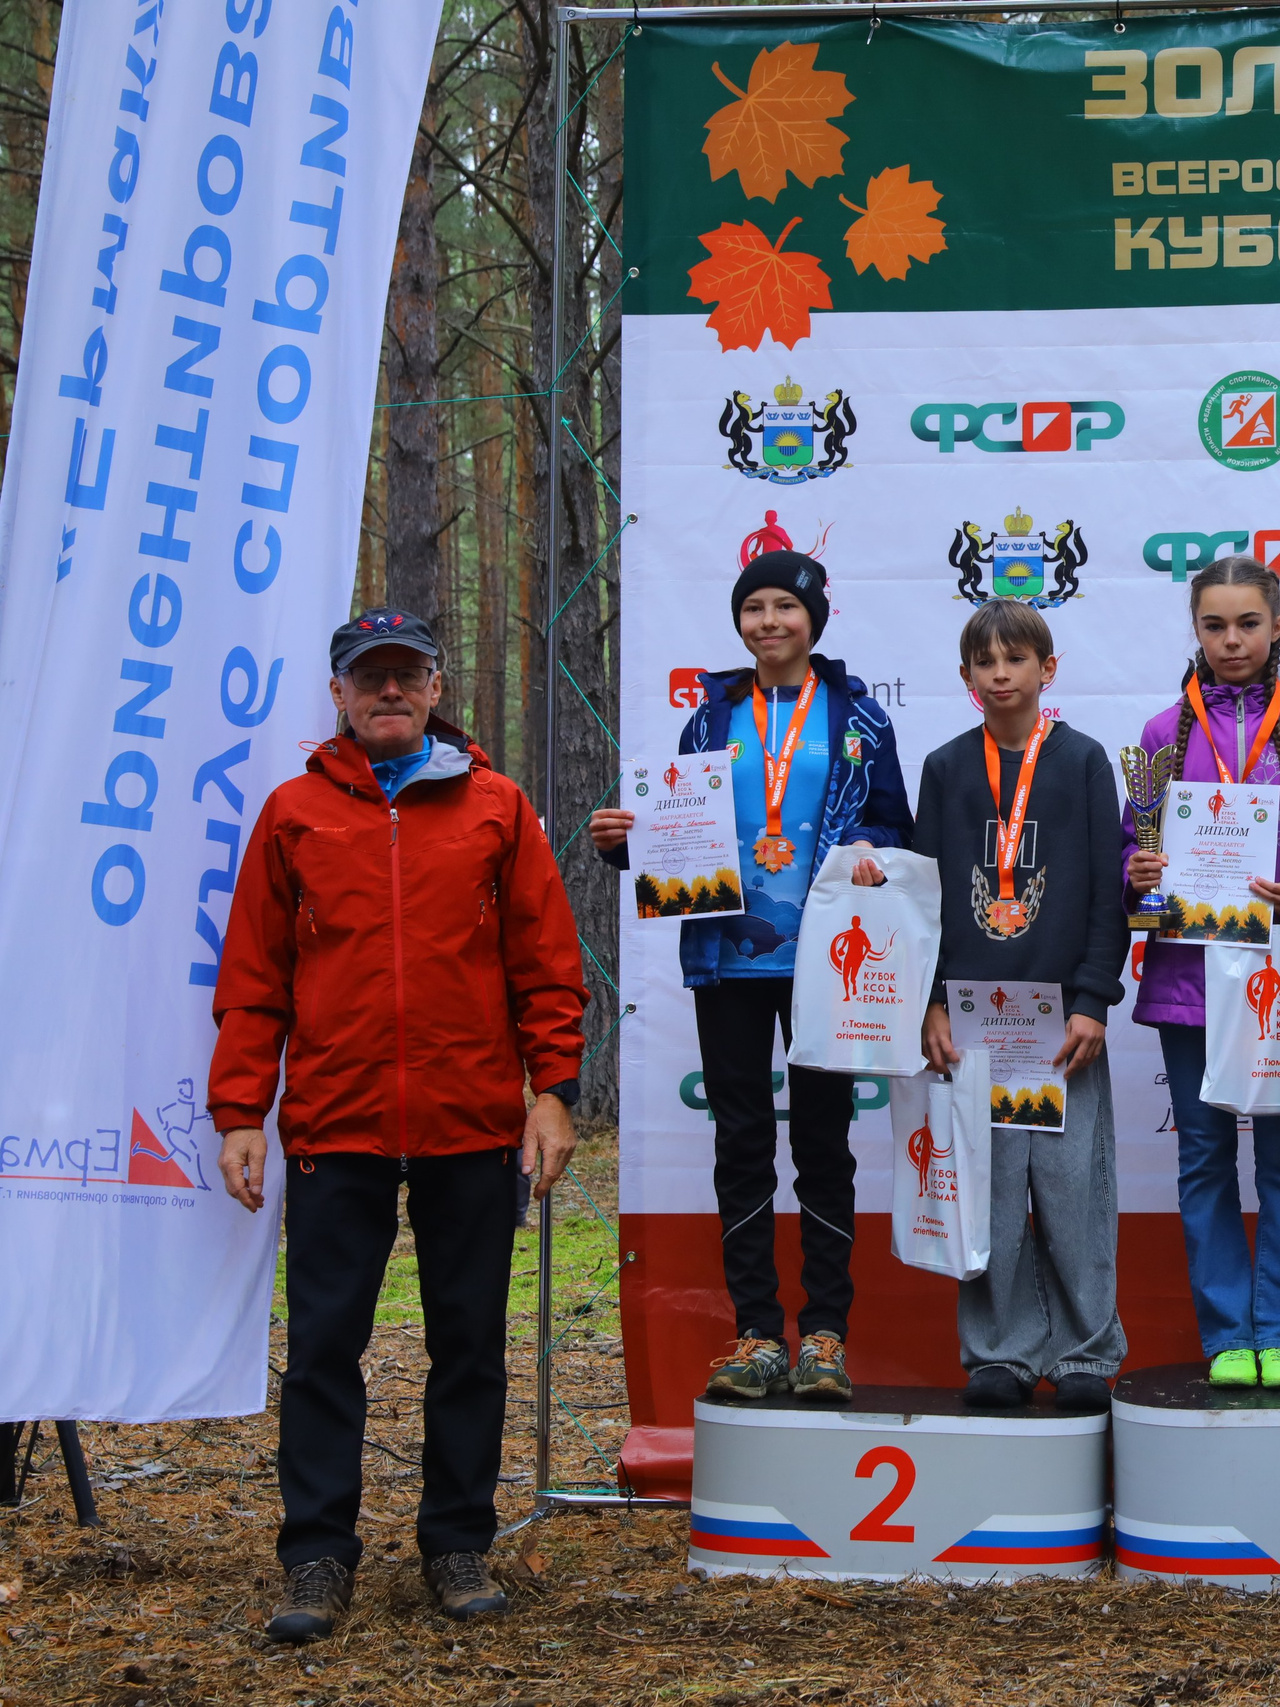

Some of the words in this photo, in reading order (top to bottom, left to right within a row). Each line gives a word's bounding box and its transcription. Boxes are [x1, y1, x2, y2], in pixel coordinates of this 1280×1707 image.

[1203, 385, 1226, 423] ФЕДЕРАЦИЯ
[1229, 375, 1278, 390] СПОРТИВНОГО
[771, 780, 784, 807] КУБОК
[654, 796, 707, 812] ДИПЛОМ
[1003, 842, 1015, 869] КУБОК
[1010, 823, 1019, 840] КСО
[1026, 732, 1041, 764] ТЮМЕНЬ
[1194, 825, 1250, 837] ДИПЛОМ
[777, 841, 788, 852] 2
[1010, 904, 1020, 915] 2
[863, 971, 896, 982] КУБОК
[863, 983, 885, 992] КСО
[856, 994, 904, 1004] «ЕРМАК»
[842, 1019, 887, 1030] г.Тюмень
[981, 1017, 1036, 1027] ДИПЛОМ
[836, 1031, 891, 1041] orienteer.ru
[848, 1445, 917, 1543] 2
